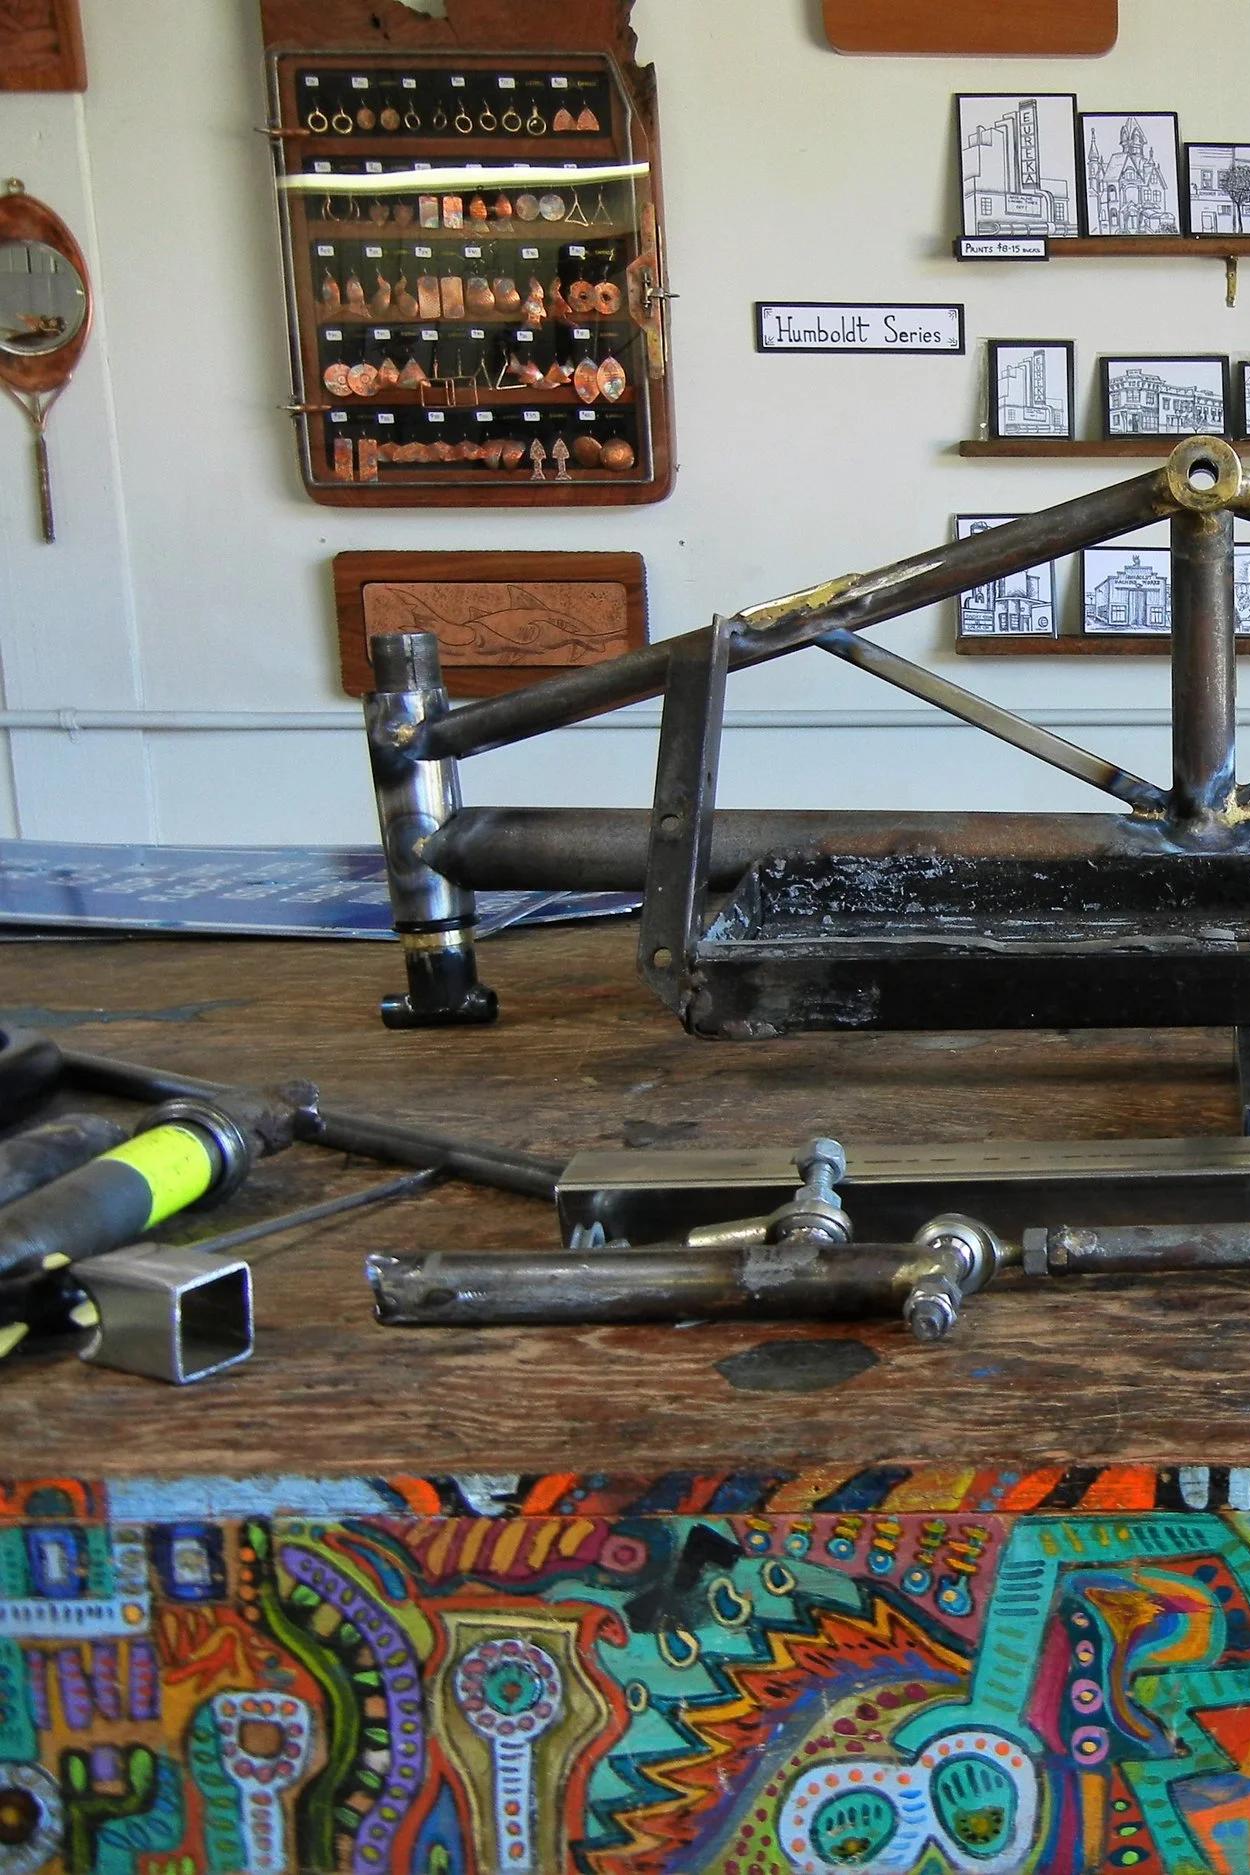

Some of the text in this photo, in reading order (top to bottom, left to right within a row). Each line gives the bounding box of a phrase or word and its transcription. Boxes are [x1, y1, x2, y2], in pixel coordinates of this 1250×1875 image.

[1023, 111, 1036, 184] EUREKA
[965, 242, 993, 253] PRINTS
[997, 242, 1020, 253] $8-15
[775, 314, 941, 343] Humboldt Series
